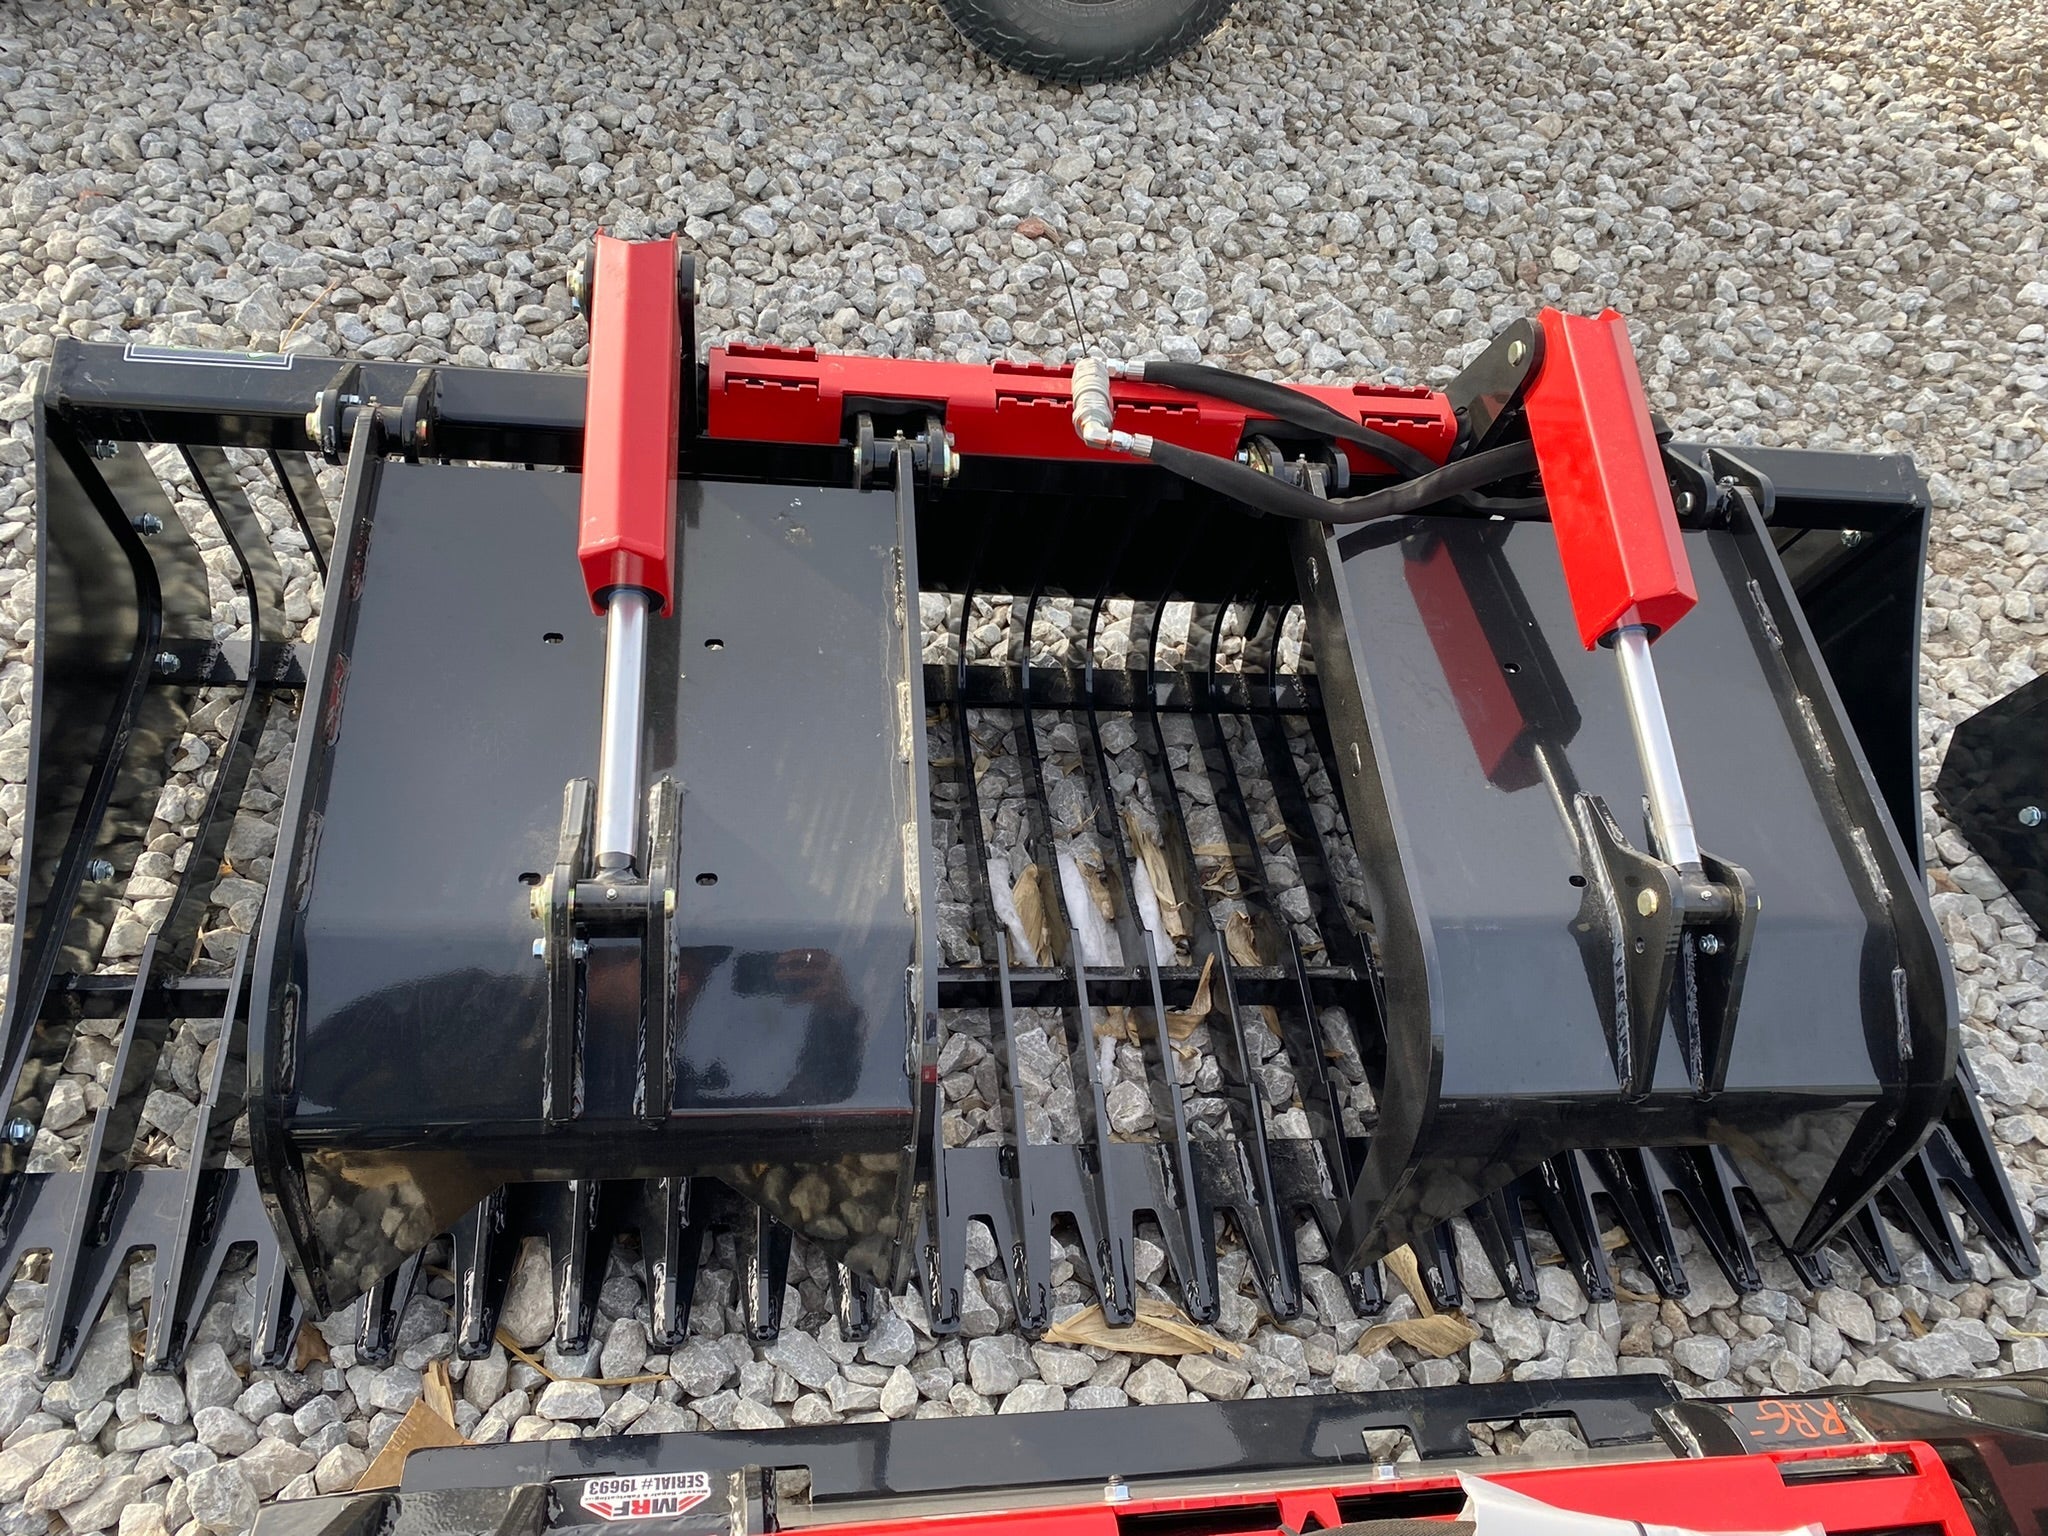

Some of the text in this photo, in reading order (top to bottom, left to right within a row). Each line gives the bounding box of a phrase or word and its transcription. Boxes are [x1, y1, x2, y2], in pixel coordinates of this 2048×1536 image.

[589, 1474, 704, 1496] SERIAL# 19693
[613, 1497, 678, 1517] MRF
